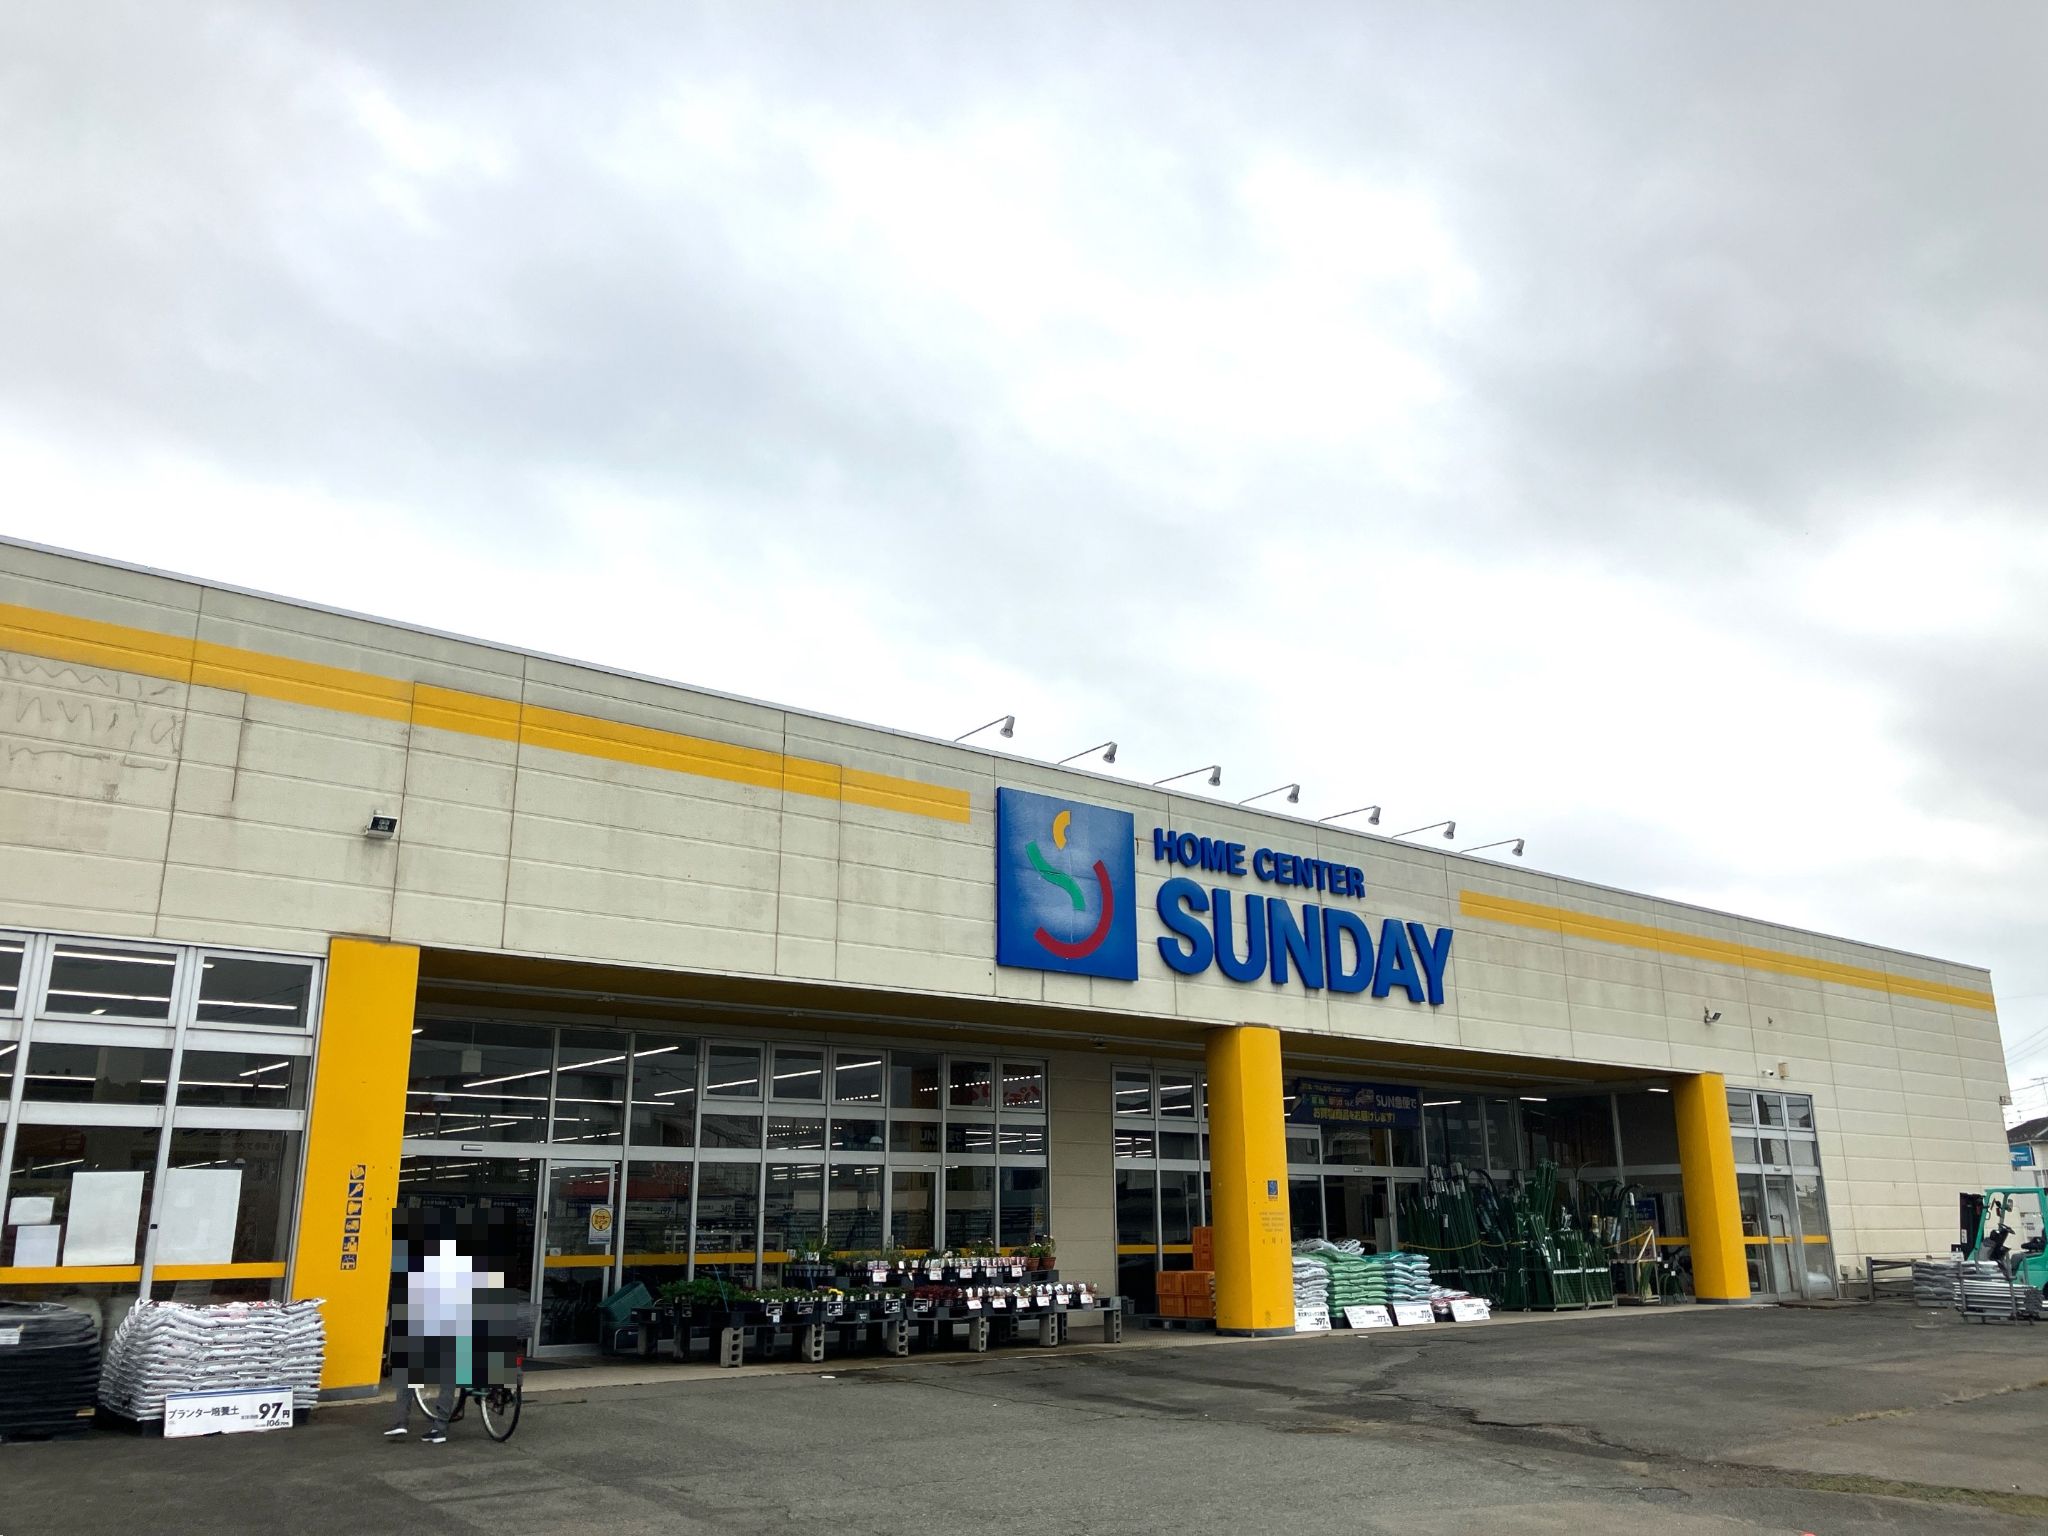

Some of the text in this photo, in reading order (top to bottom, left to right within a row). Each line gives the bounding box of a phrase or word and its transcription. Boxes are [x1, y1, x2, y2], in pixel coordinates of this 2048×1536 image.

[1154, 827, 1366, 899] HOME CENTER
[1157, 876, 1454, 1005] SUNDAY
